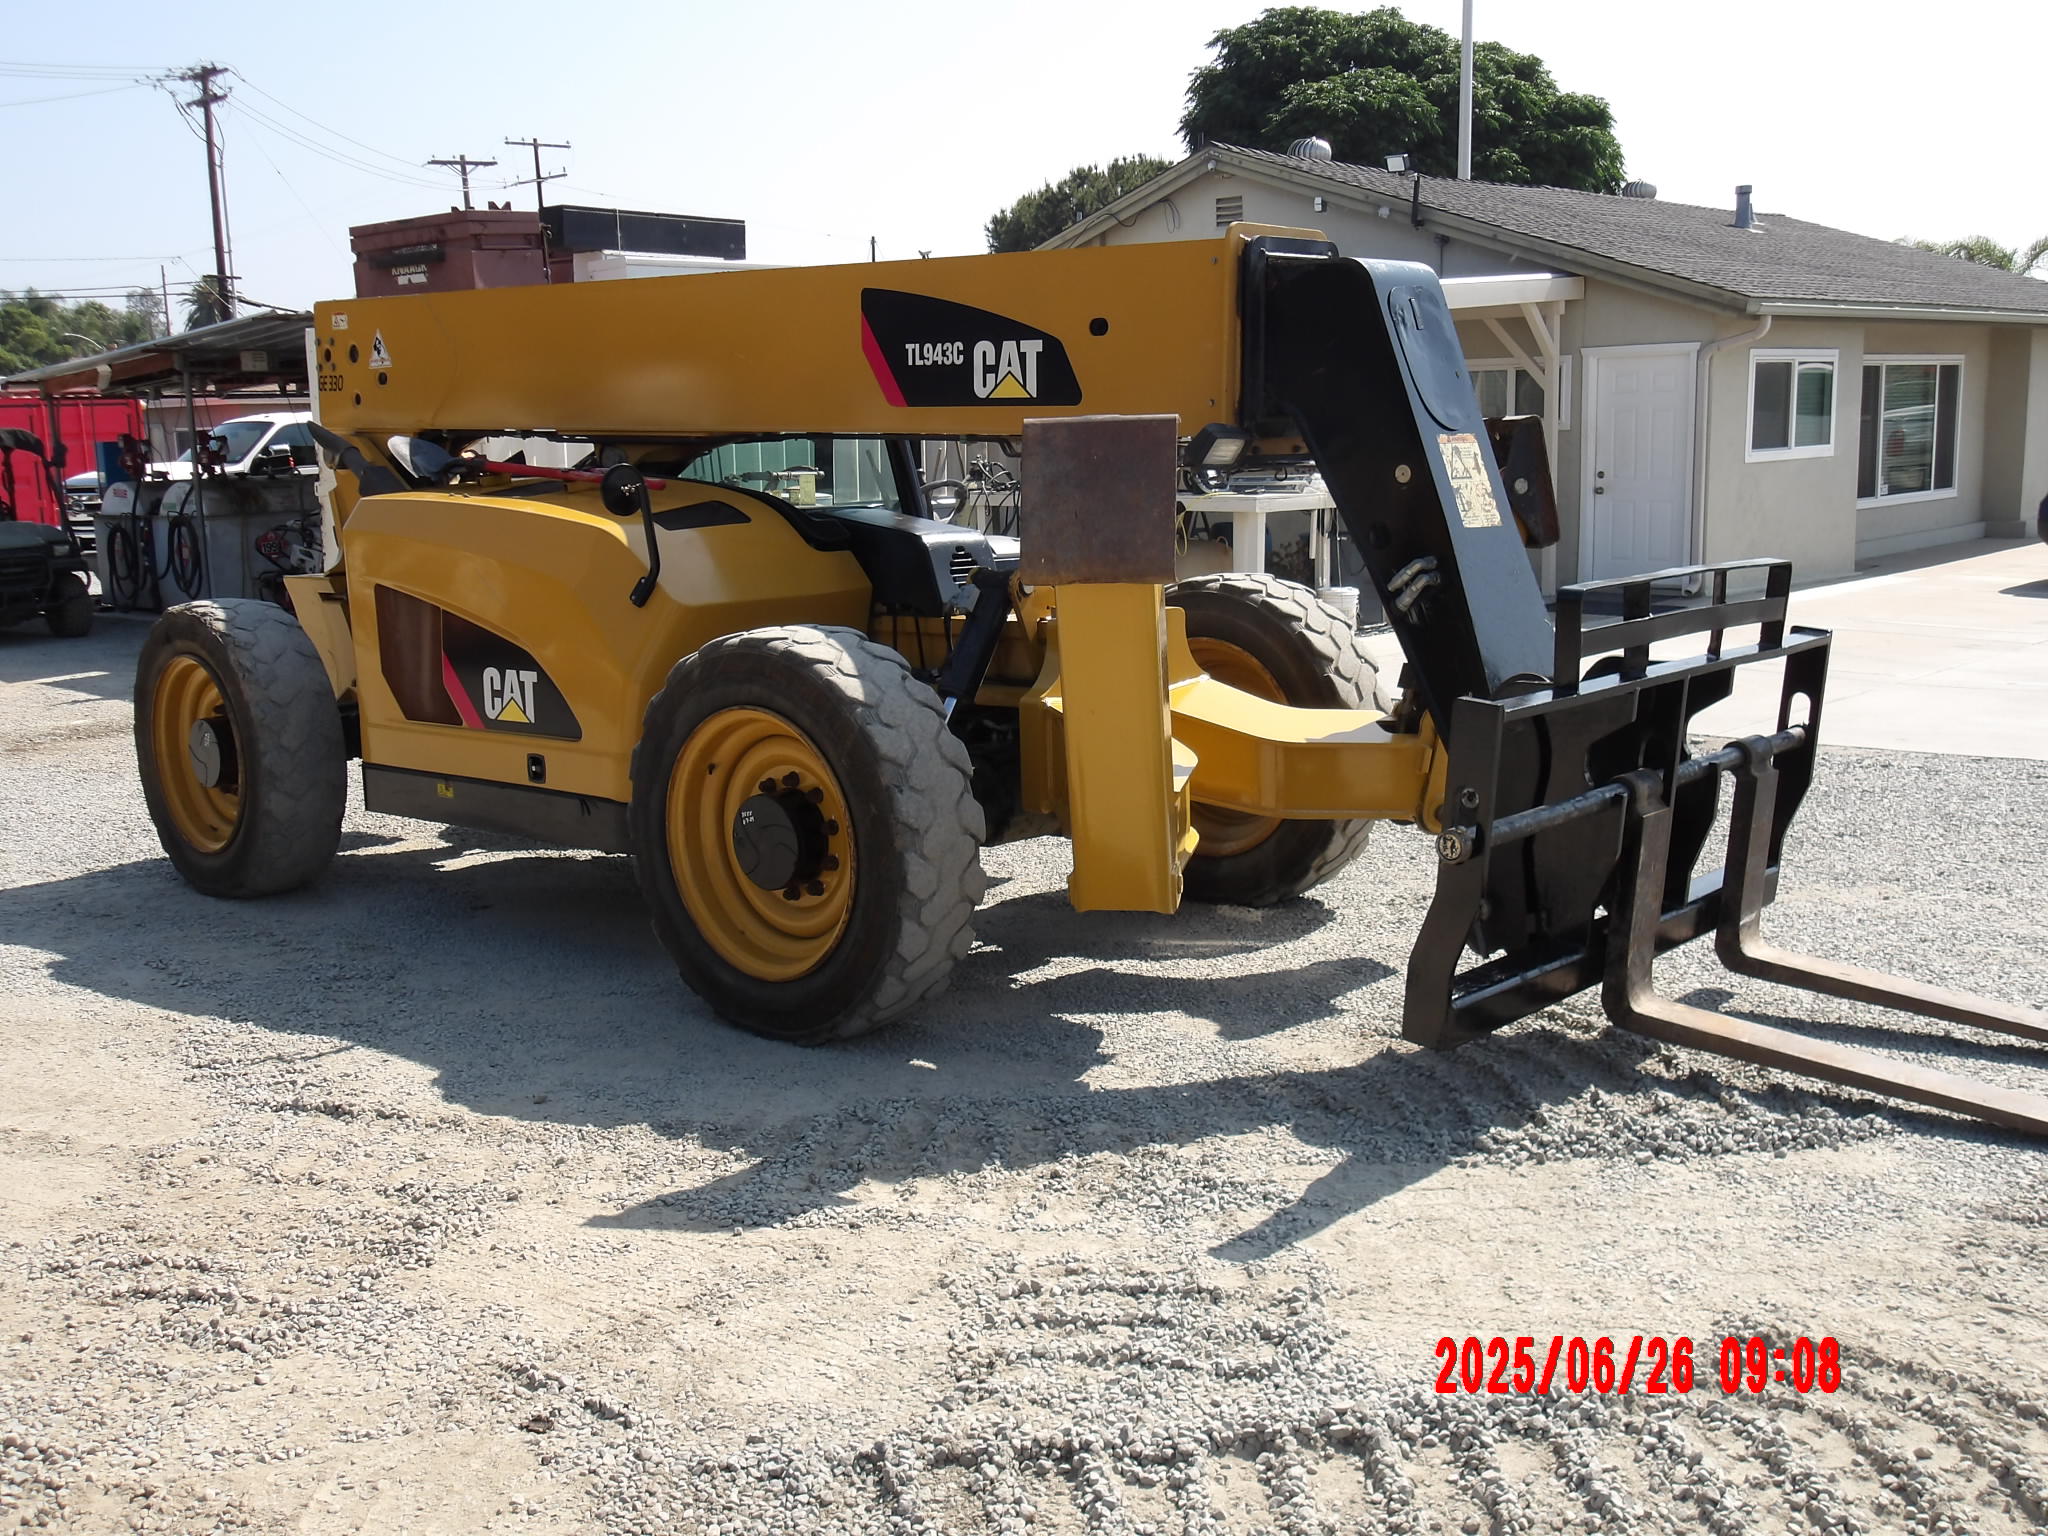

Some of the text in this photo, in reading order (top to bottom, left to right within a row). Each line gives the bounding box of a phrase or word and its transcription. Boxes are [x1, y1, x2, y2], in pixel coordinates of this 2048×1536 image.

[905, 339, 1043, 399] TL943C CAT
[482, 666, 538, 724] CAT
